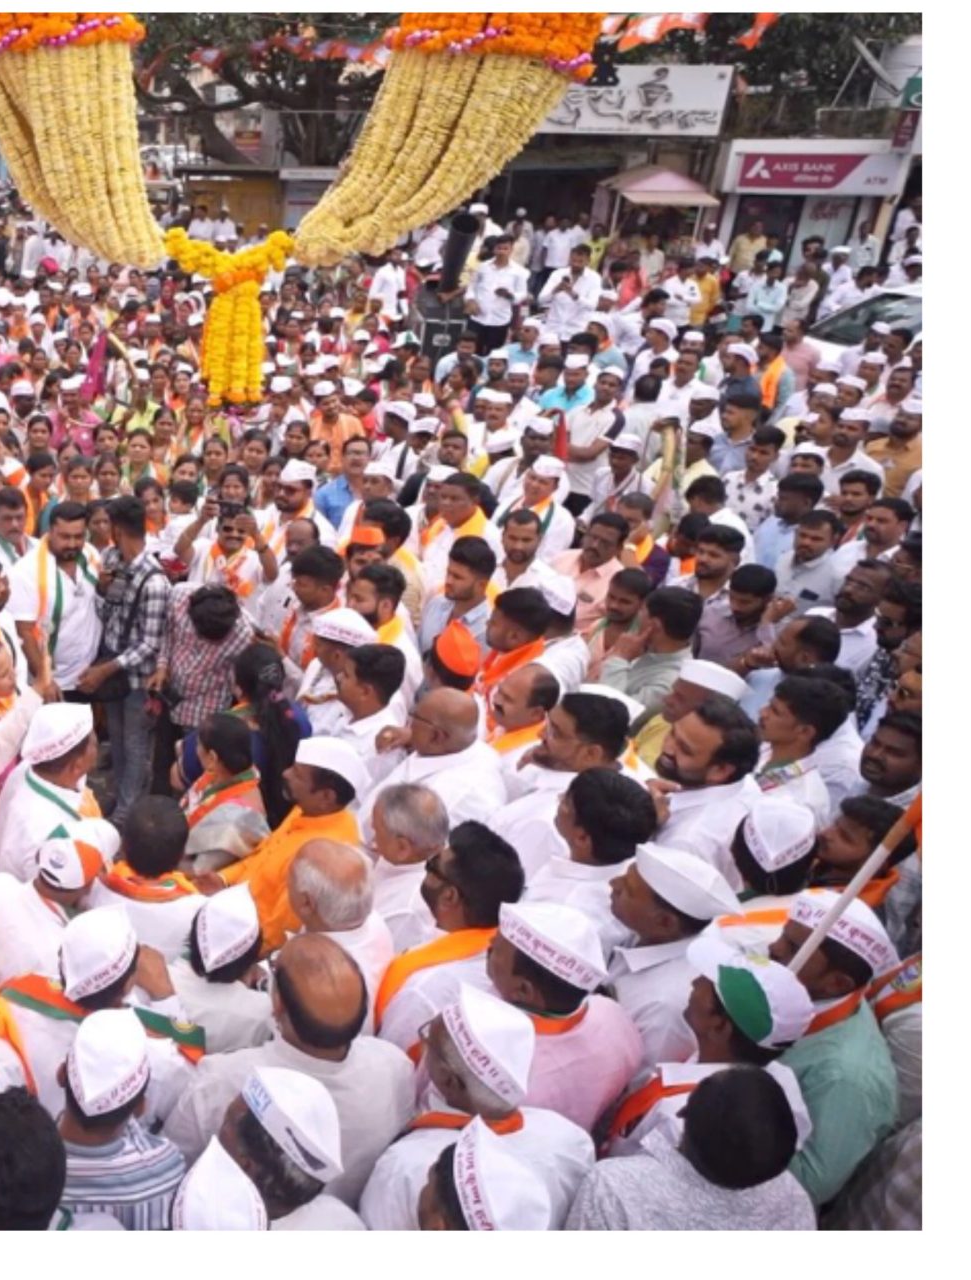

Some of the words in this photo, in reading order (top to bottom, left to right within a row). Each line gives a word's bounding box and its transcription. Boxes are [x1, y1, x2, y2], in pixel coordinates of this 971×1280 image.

[771, 162, 800, 172] AXIS
[802, 162, 838, 173] BANK
[864, 176, 889, 187] ATM
